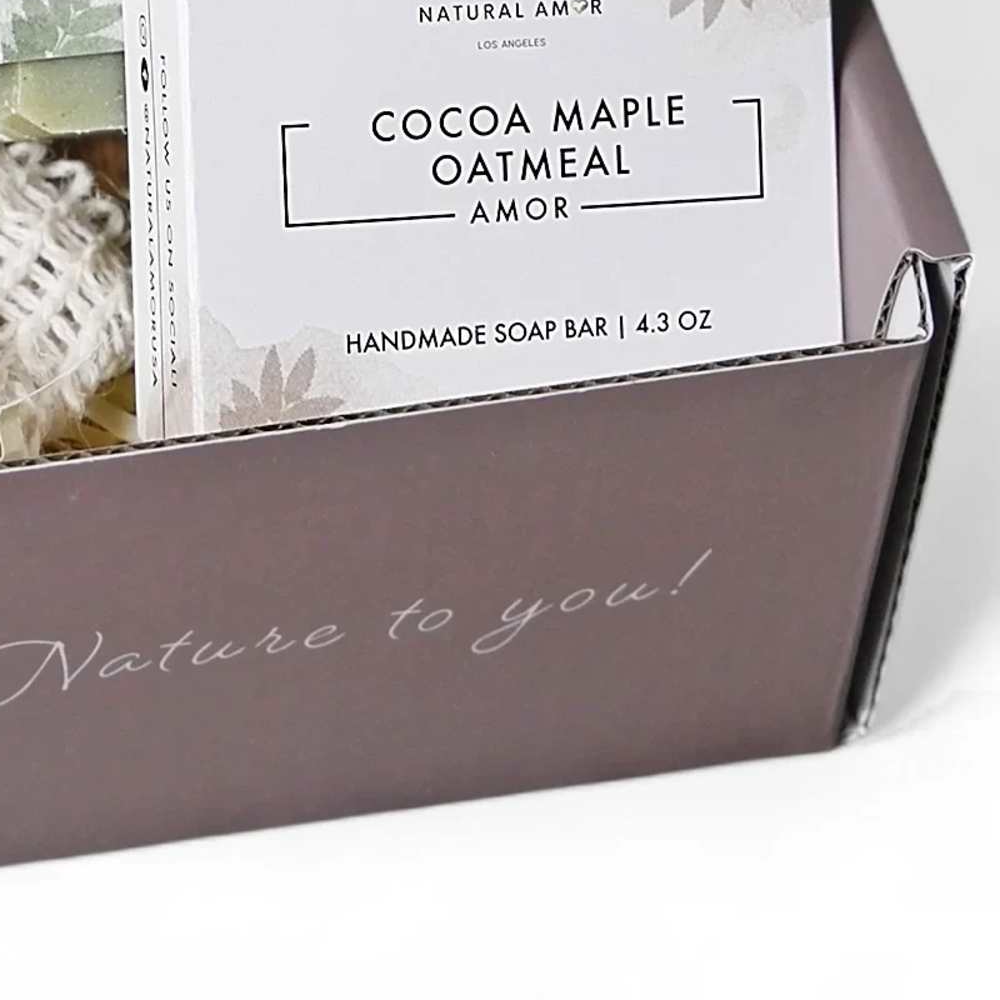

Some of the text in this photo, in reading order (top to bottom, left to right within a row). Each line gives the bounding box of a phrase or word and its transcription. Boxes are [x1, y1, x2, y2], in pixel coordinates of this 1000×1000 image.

[419, 2, 525, 24] NATURAL
[477, 37, 547, 51] LOS ANGELES
[159, 54, 171, 166] FOLLOW
[371, 94, 685, 143] COCOA MAPLE
[431, 144, 631, 186] OATMEAL
[164, 178, 174, 212] US
[469, 195, 569, 225] AMOR
[166, 223, 175, 269] ON
[346, 324, 487, 355] HANDMADE
[494, 319, 557, 344] SOAP
[564, 316, 609, 339] BAR
[635, 311, 670, 334] 4.3
[677, 309, 713, 331] OZ
[388, 598, 453, 640] to
[471, 548, 713, 655] you!
